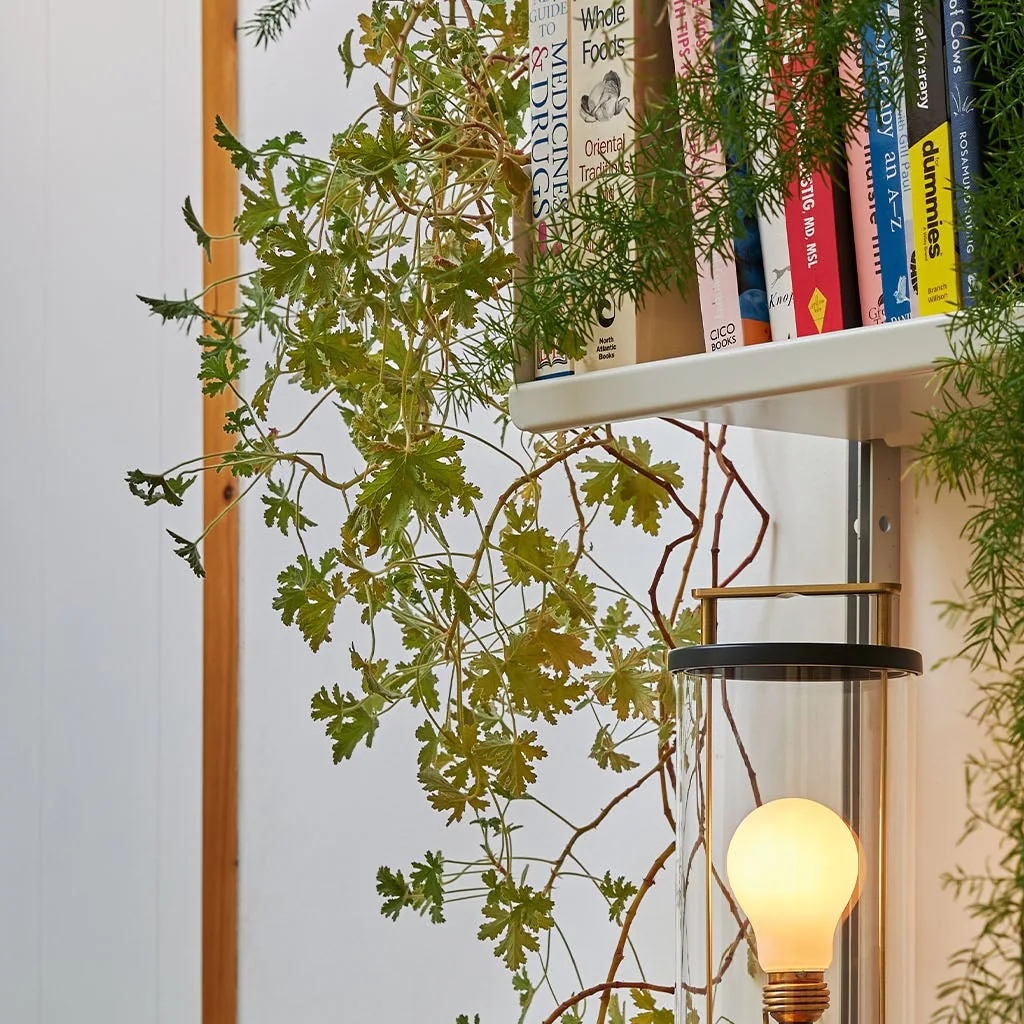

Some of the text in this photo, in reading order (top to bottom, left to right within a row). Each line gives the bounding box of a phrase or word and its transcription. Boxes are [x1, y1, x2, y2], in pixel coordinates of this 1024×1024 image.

[530, 2, 568, 23] GUIDE
[580, 4, 626, 31] Whole
[539, 21, 556, 37] TO
[677, 22, 691, 58] TIPS
[582, 34, 626, 64] Foods
[951, 21, 966, 74] Cows
[531, 46, 550, 219] & DRUGS
[551, 39, 569, 212] MEDICINES
[585, 133, 626, 157] Oriental
[900, 134, 909, 158] Gill
[579, 160, 631, 182] Tradits
[885, 151, 898, 180] an
[901, 161, 911, 192] Paul
[922, 140, 943, 259] dummies
[804, 216, 816, 240] MD,
[806, 243, 818, 269] MSL
[928, 283, 948, 295] Branch
[599, 337, 614, 345] North
[710, 323, 736, 341] CICO
[711, 335, 737, 352] BOOKS
[596, 344, 617, 353] Atlantic
[598, 352, 615, 361] Books
